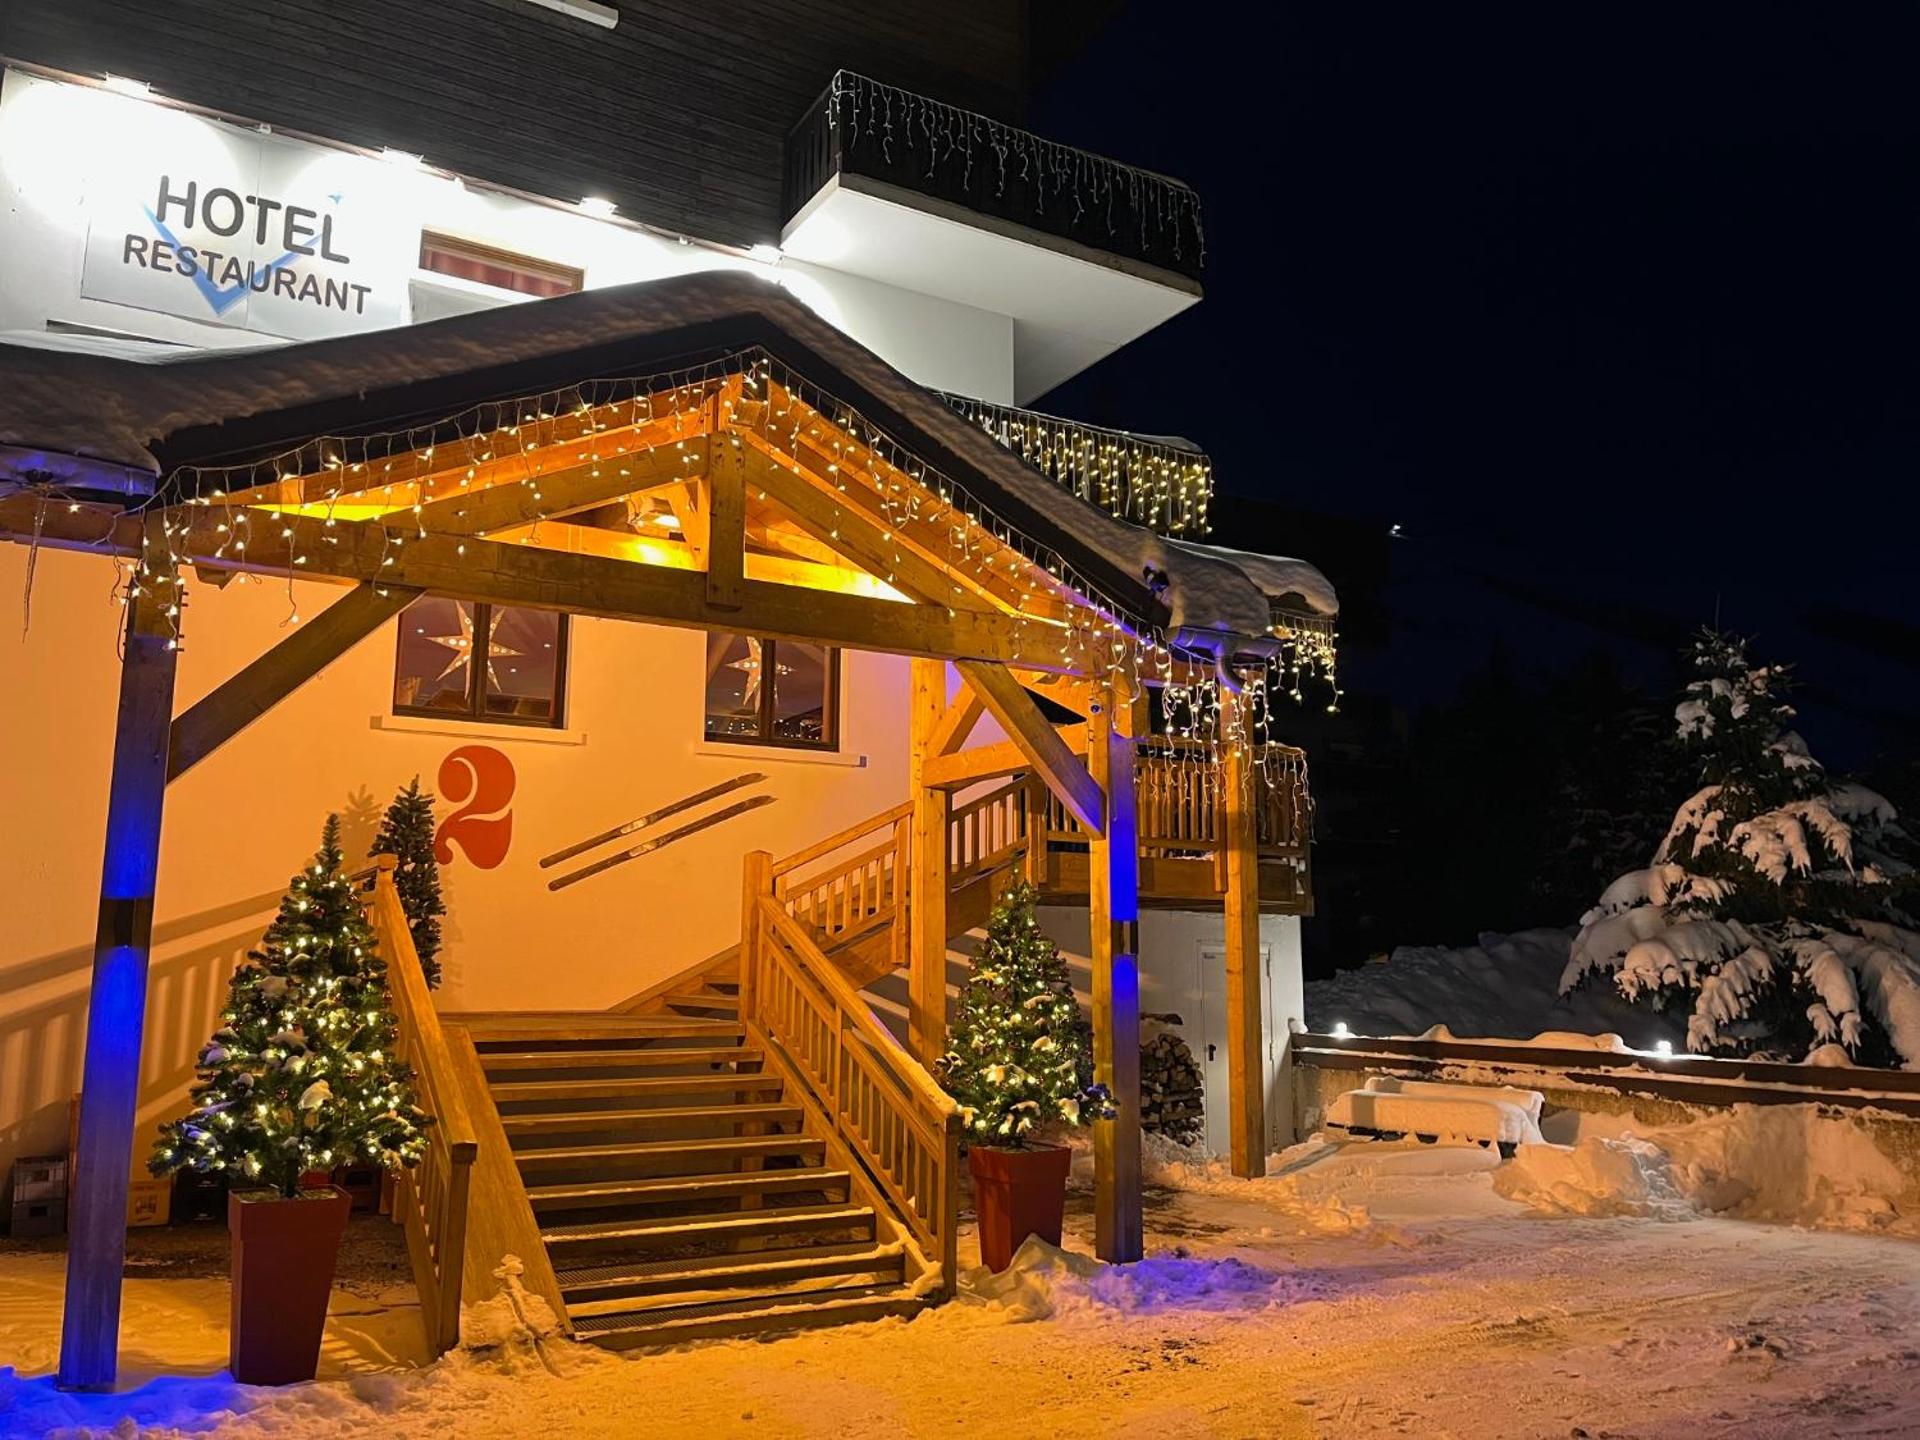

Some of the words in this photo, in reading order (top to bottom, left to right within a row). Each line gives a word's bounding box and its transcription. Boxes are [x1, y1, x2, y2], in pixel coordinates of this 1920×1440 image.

[156, 175, 350, 264] HOTEL
[123, 234, 372, 315] RESTAURANT
[434, 745, 516, 870] 2
